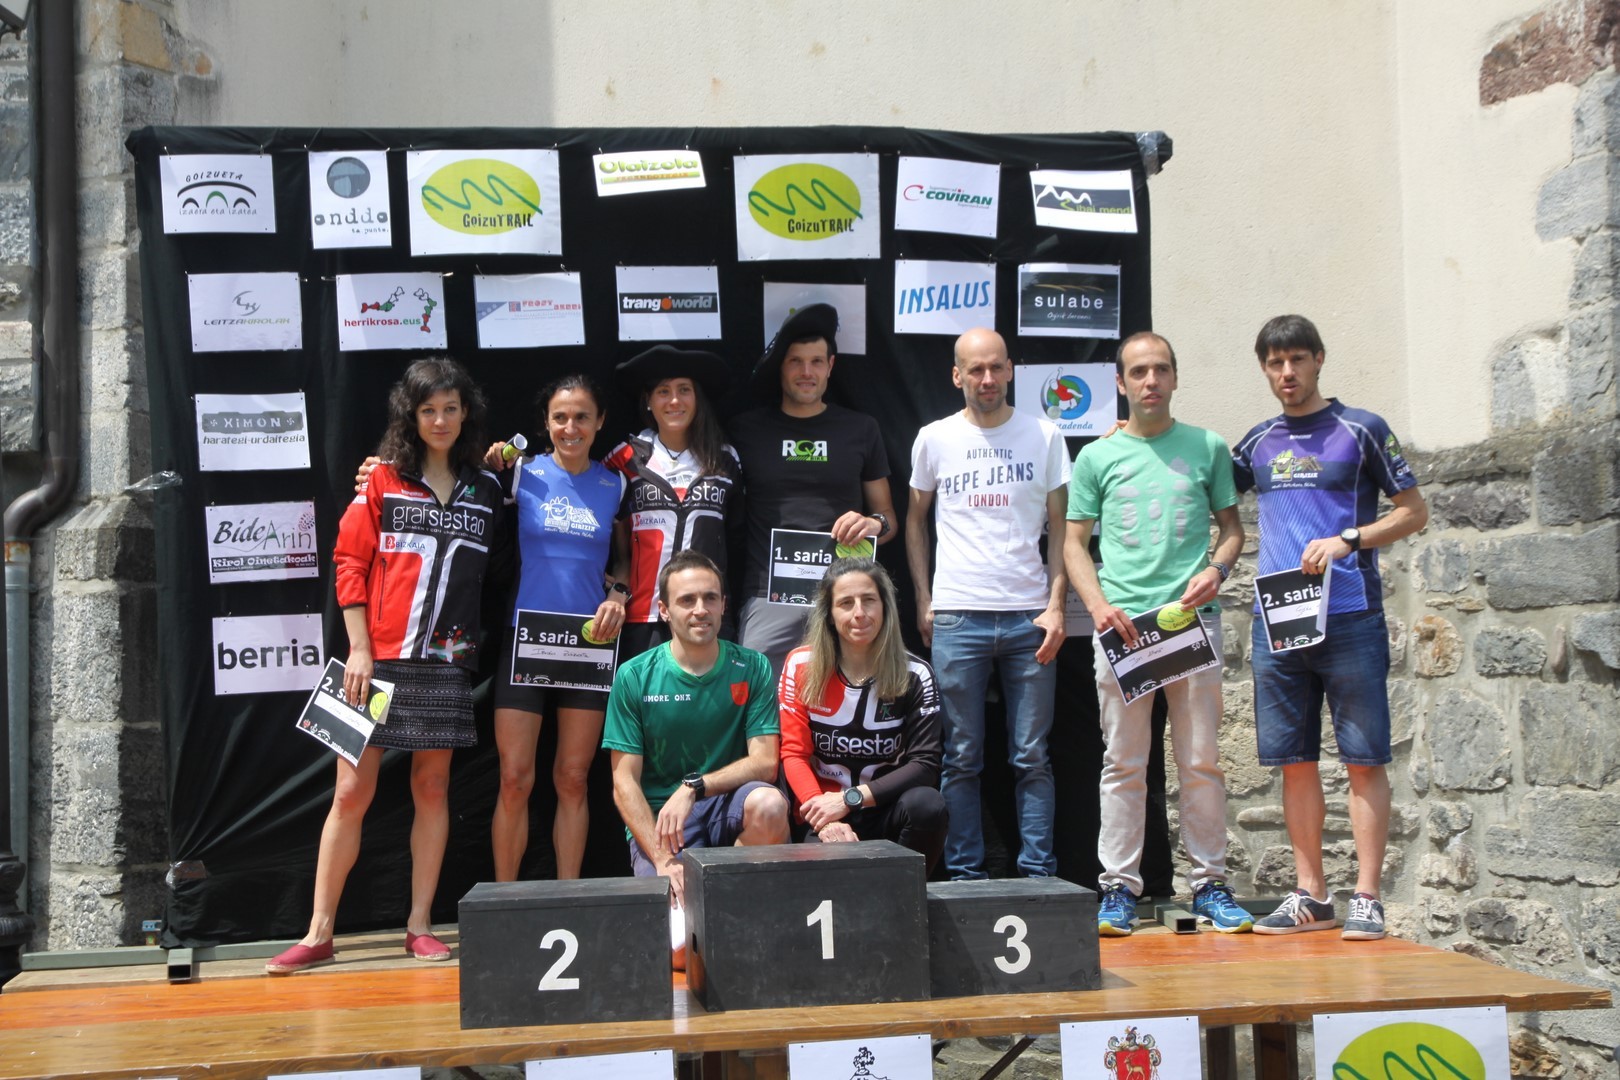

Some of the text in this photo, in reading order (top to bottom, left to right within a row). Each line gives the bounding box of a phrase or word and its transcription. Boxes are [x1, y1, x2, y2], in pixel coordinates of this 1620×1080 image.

[599, 158, 698, 174] Olaizola
[185, 171, 243, 183] GOIZUETA
[314, 208, 388, 226] onddo
[898, 280, 991, 315] INSALUS
[1034, 294, 1103, 309] sulabe
[344, 318, 421, 327] herrikrosa.eus
[966, 448, 1013, 460] AUTHENTIC
[945, 462, 1034, 496] PEPE JEANS
[968, 494, 1009, 507] LONDON
[396, 541, 426, 550] BIZKAIA
[212, 557, 244, 568] Kirol
[774, 547, 833, 564] 1. saria
[1262, 584, 1322, 608] 2. saria
[519, 627, 578, 645] 3. saria
[217, 638, 320, 670] berria
[1107, 648, 1121, 663] 3.
[322, 676, 334, 693] 2.
[643, 694, 669, 703] UMORE
[814, 729, 902, 755] rafsestao
[807, 900, 835, 960] 1
[993, 915, 1032, 974] 3
[538, 929, 580, 991] 2
